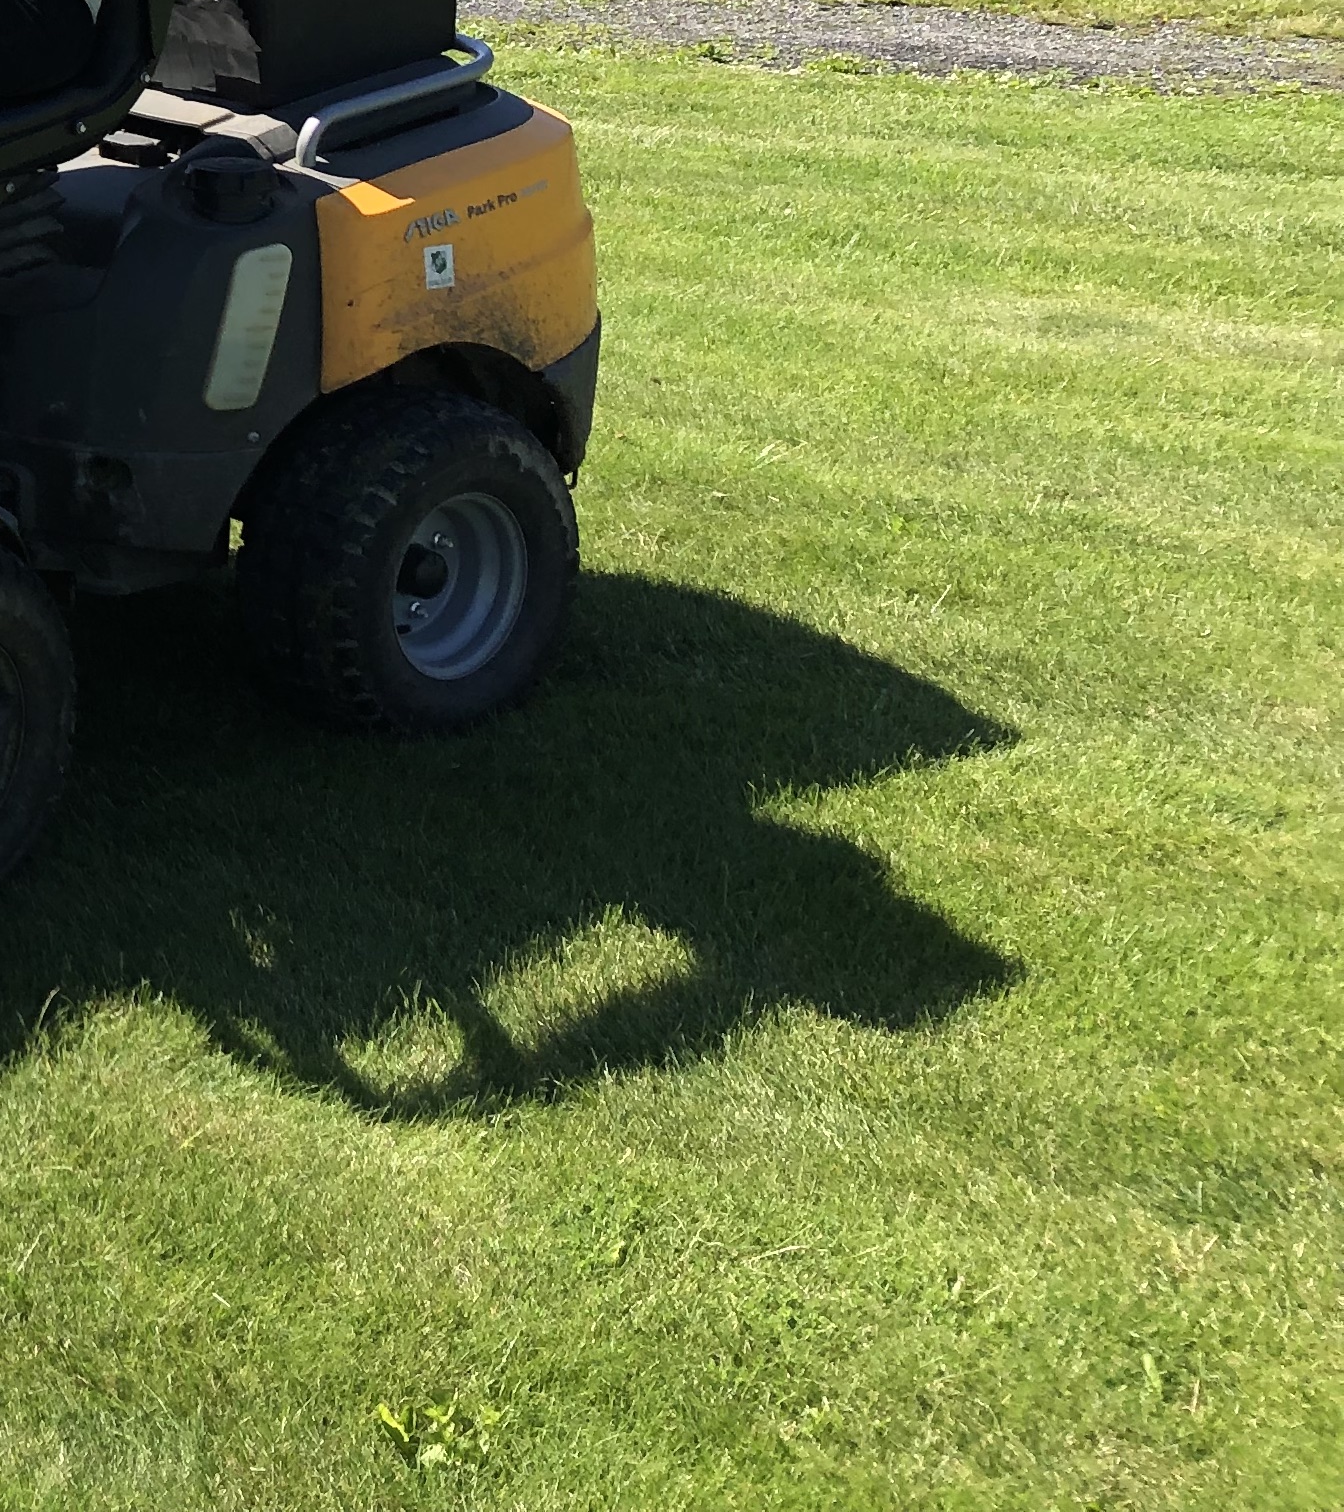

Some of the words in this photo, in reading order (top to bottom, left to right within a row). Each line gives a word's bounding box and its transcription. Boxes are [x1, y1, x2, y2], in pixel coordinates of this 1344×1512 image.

[403, 207, 460, 244] STIGA
[467, 199, 496, 219] Park
[497, 192, 518, 209] Pro
